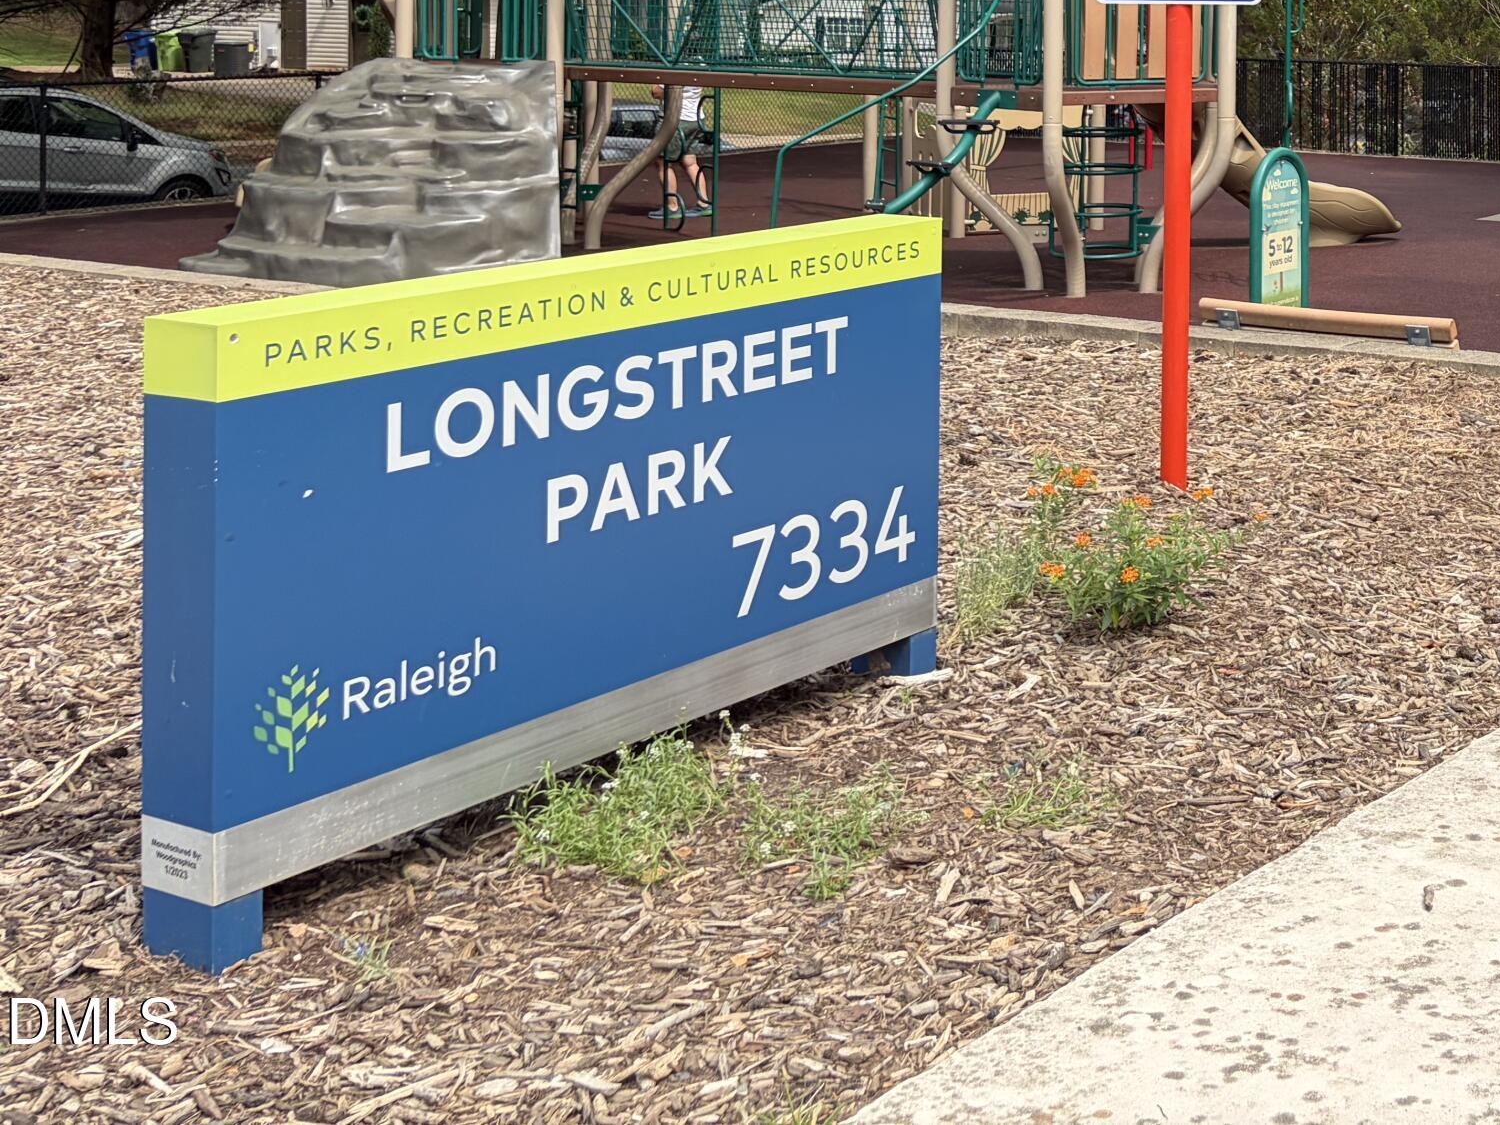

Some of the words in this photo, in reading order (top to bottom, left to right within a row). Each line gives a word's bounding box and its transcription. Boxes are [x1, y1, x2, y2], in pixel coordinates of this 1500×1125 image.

[1266, 178, 1298, 191] Welcome
[1268, 238, 1276, 257] 5
[1282, 235, 1293, 254] 12
[1268, 257, 1283, 269] years
[1284, 254, 1293, 265] old
[264, 326, 393, 368] PARKS,
[410, 289, 606, 343] RECREATION
[620, 286, 634, 307] &
[647, 264, 779, 303] CULTURAL
[790, 240, 921, 280] RESOURCES
[384, 316, 849, 474] LONGSTREET
[545, 435, 733, 544] PARK
[731, 484, 917, 618] 7334
[342, 637, 497, 722] Raleigh
